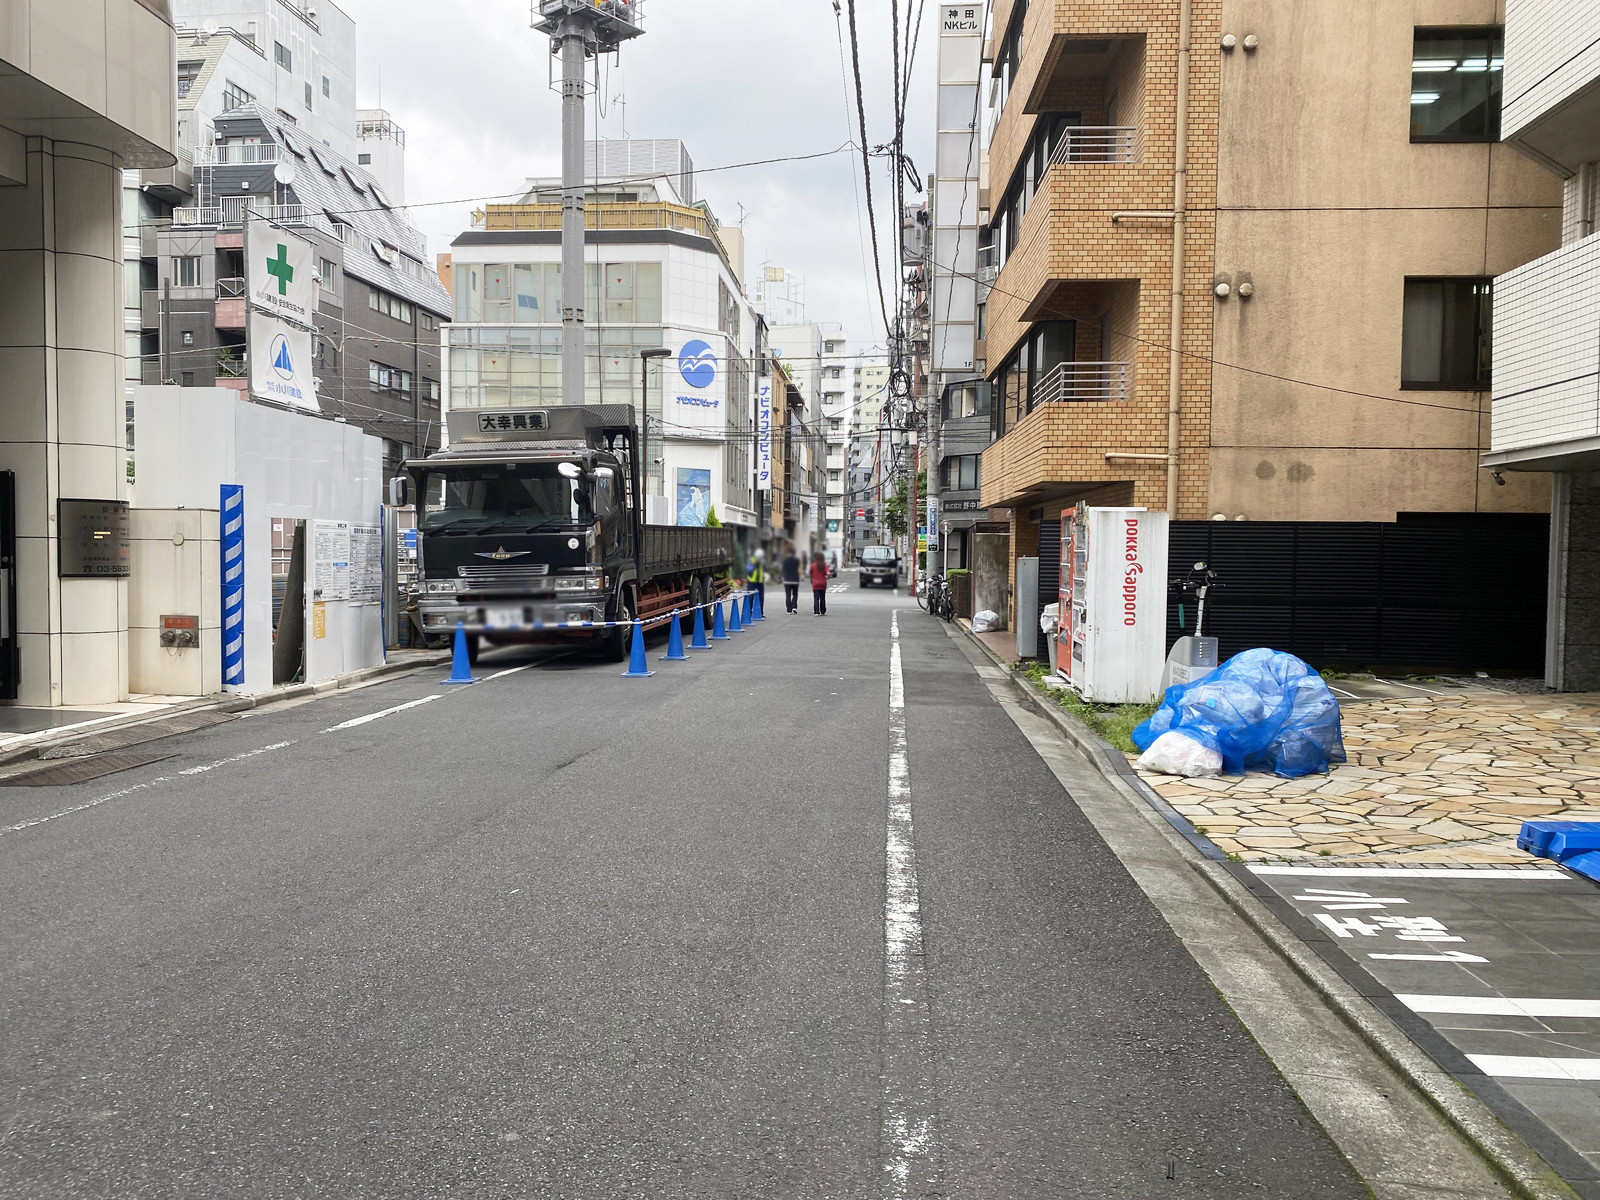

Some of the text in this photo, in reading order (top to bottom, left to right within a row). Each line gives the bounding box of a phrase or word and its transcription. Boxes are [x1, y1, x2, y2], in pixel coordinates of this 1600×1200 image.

[948, 9, 975, 19] 神田
[944, 21, 978, 30] NKビル
[481, 414, 544, 430] 大幸興業
